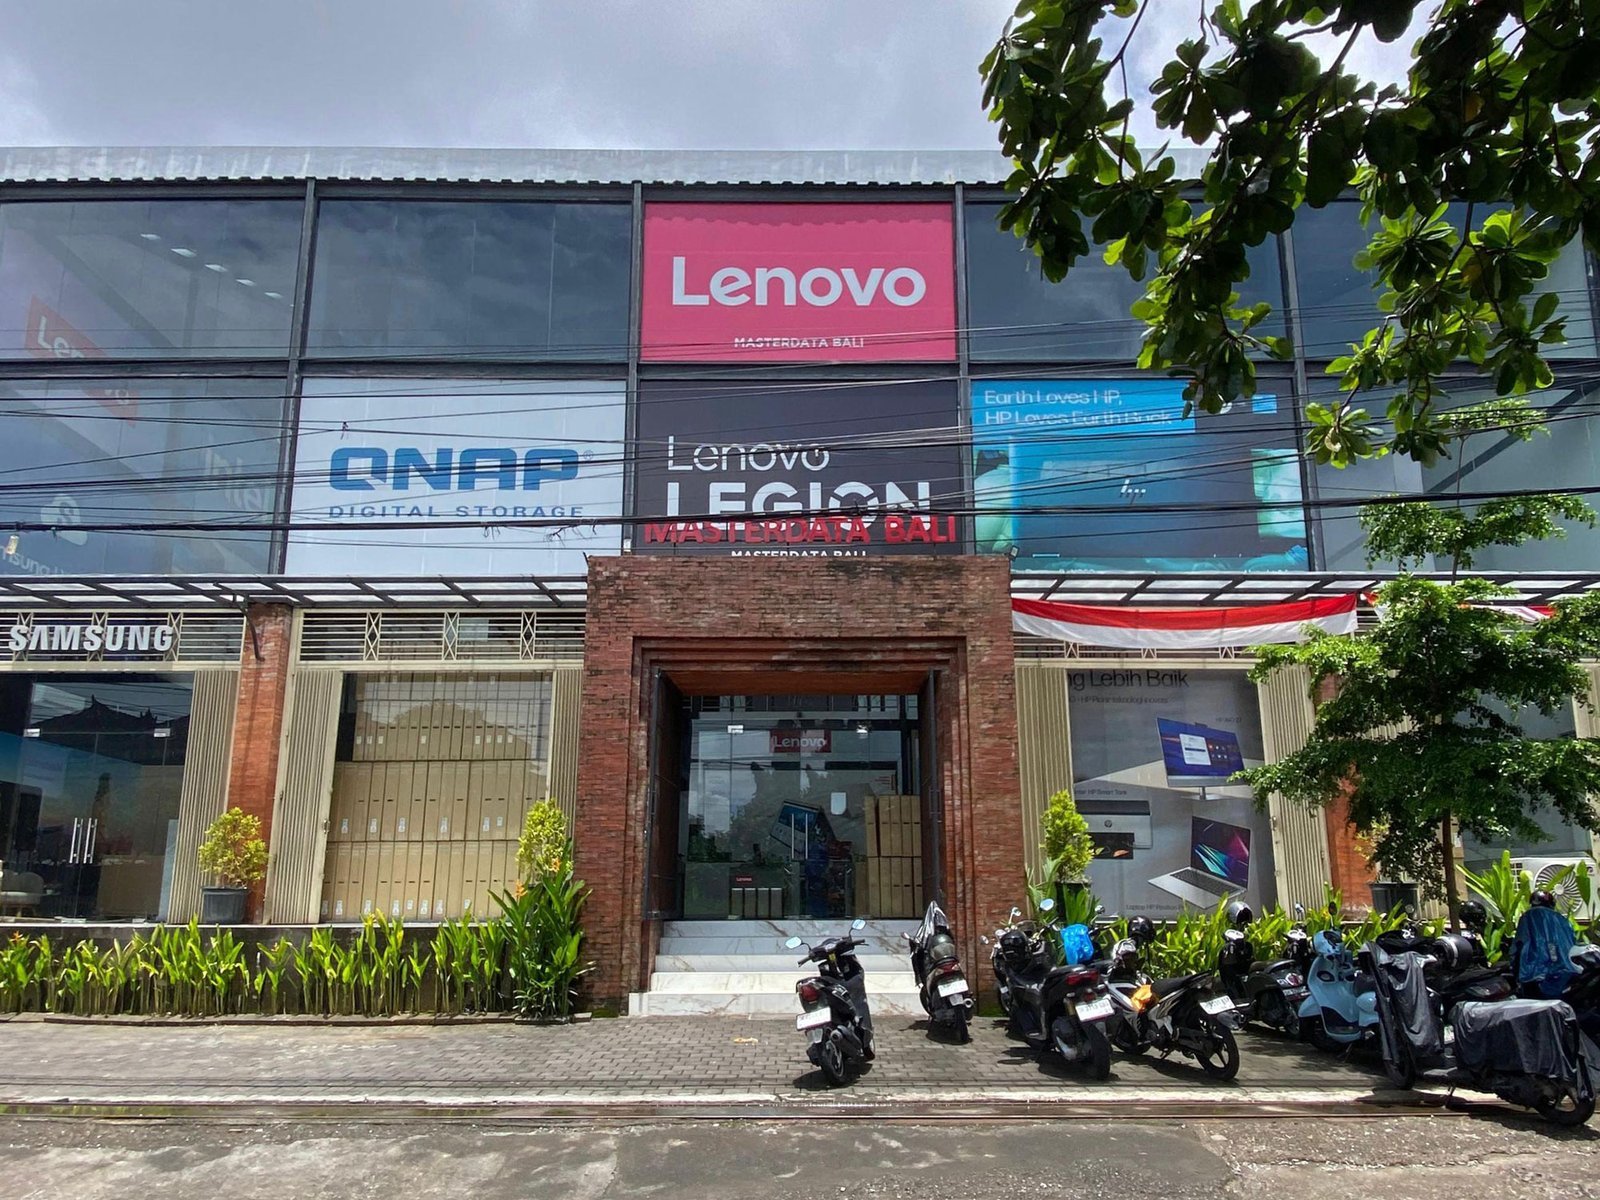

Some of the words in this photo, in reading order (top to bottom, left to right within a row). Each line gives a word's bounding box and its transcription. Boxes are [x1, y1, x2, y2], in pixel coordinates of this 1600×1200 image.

[672, 256, 927, 307] Lenovo
[734, 337, 828, 348] MASTERDATA
[833, 336, 864, 348] BALI
[985, 390, 1032, 405] Earth
[1037, 390, 1090, 405] Loves
[985, 411, 1011, 425] HP
[1016, 411, 1069, 425] Loves
[1073, 411, 1121, 425] Earth
[667, 435, 830, 472] Lenovo
[329, 447, 579, 491] QNAP
[329, 506, 441, 519] DIGITAL
[456, 506, 583, 518] STORAGE
[667, 481, 931, 531] LEGION
[644, 515, 871, 544] MASTERDATA
[884, 515, 957, 544] BALI
[8, 625, 174, 651] SAMSUNG
[1090, 669, 1143, 688] Lebih
[1147, 669, 1190, 688] Baik
[775, 736, 826, 748] Lenovo
